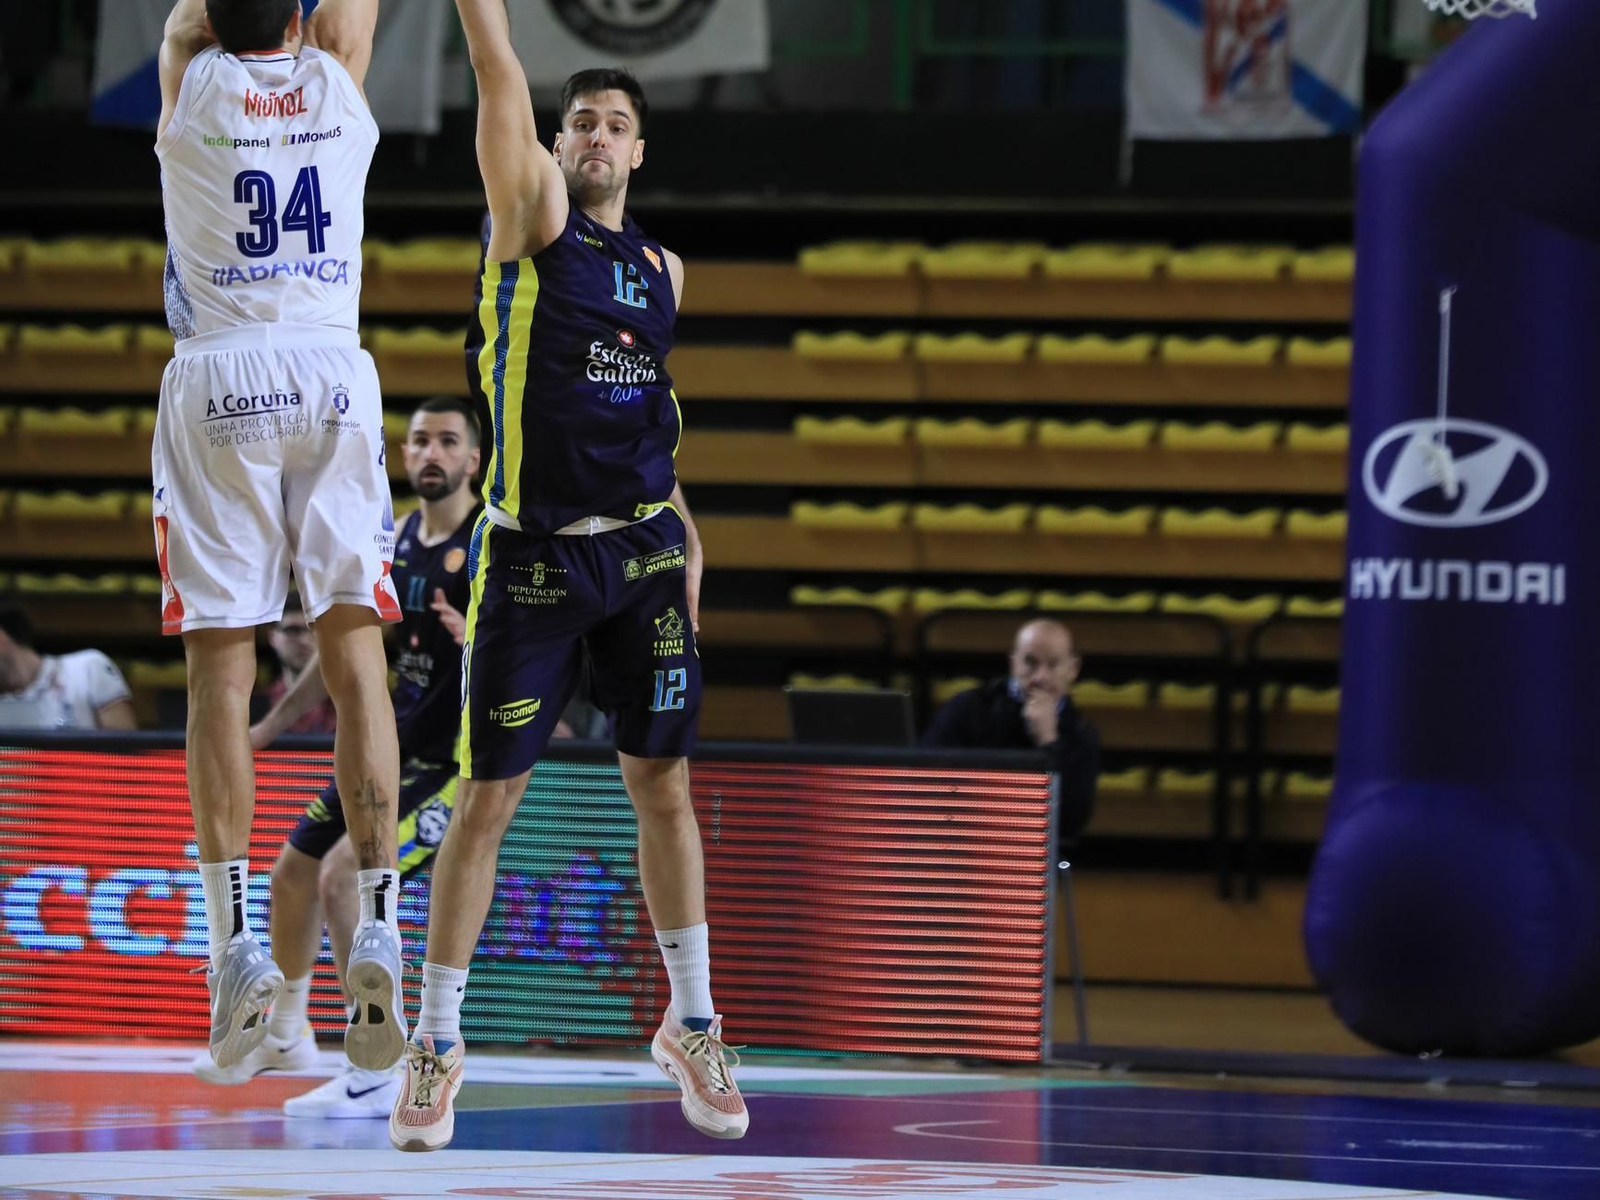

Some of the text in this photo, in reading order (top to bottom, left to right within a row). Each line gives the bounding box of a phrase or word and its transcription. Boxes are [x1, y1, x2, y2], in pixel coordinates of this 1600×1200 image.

[244, 85, 308, 117] MUÑOZ
[203, 133, 270, 149] indupanel
[233, 165, 332, 258] 34
[222, 258, 348, 286] ABANCA
[612, 260, 649, 309] 12
[206, 388, 301, 417] A Coruña
[204, 412, 308, 437] UNHA PROVINCIA
[210, 424, 304, 448] POR DESCUBRIR
[643, 551, 672, 564] Concello
[405, 574, 427, 612] 11
[507, 584, 567, 597] DEPUTACIÓN
[1350, 556, 1566, 606] HYUNDAI
[513, 595, 558, 605] OURENSE
[648, 667, 687, 712] 12
